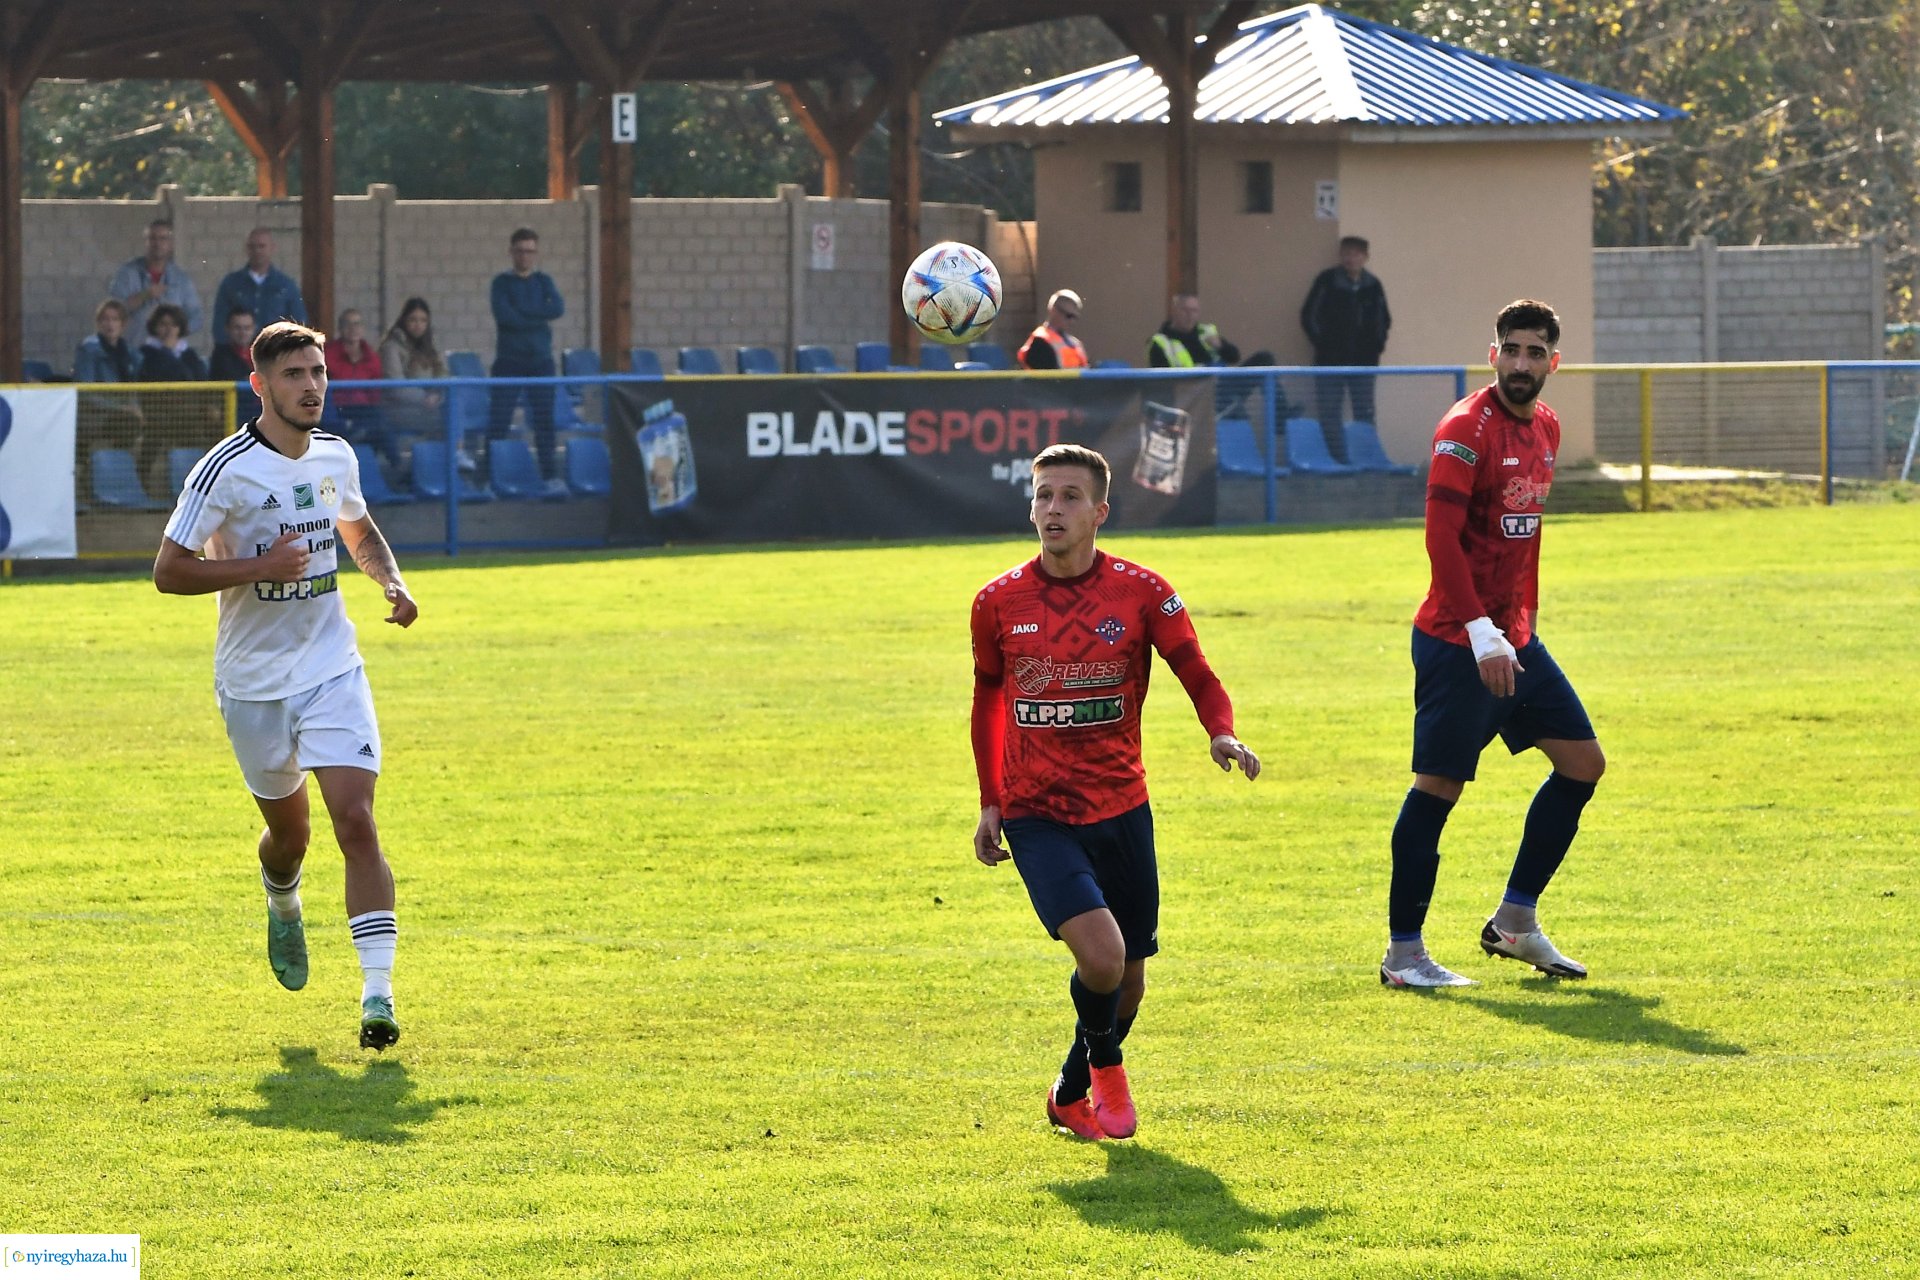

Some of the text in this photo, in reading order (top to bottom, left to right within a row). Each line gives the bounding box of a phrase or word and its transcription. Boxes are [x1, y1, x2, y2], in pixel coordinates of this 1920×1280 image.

[619, 98, 630, 137] E
[747, 408, 1069, 457] BLADESPORT
[279, 517, 330, 536] Pannon
[1011, 623, 1039, 635] JAKO
[1052, 660, 1129, 680] REVESZ
